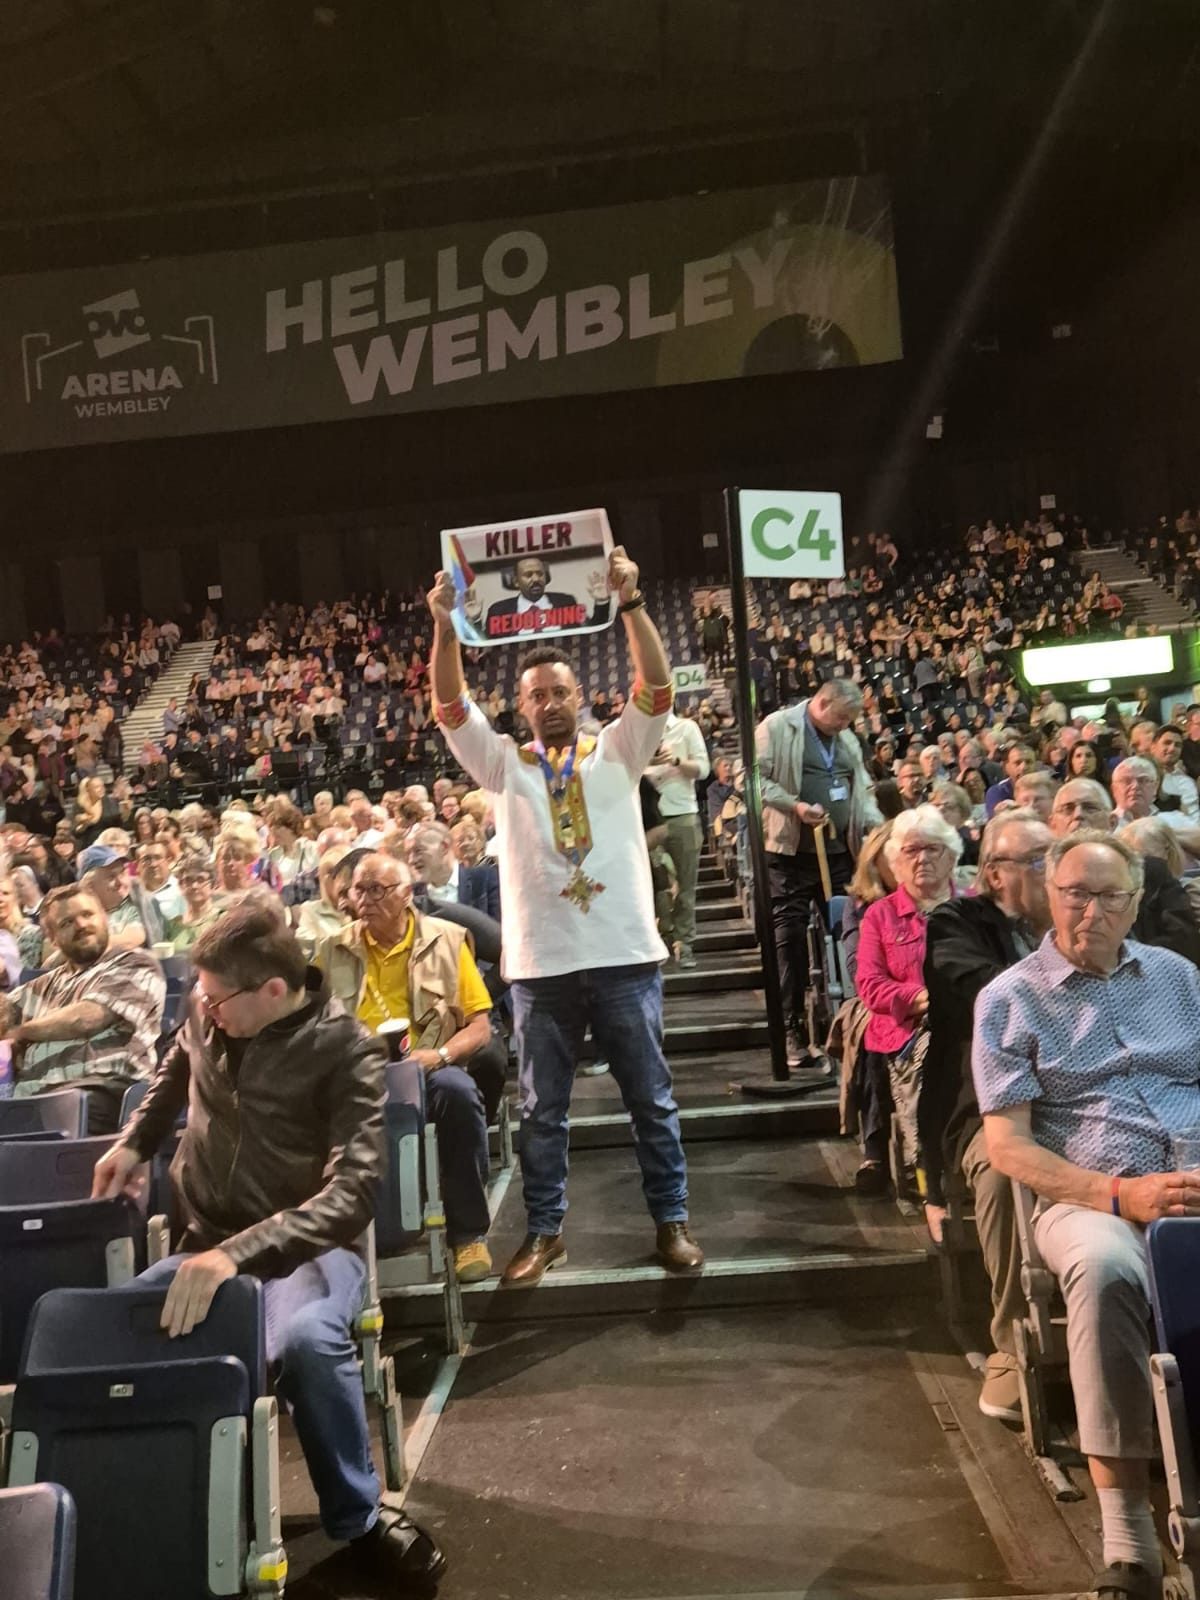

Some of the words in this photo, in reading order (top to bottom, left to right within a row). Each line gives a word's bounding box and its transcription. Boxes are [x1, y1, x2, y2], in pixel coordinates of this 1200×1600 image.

[266, 230, 548, 353] HELLO
[333, 238, 794, 404] WEMBLEY
[60, 365, 183, 400] ARENA
[74, 396, 172, 418] WEMBLEY
[485, 521, 572, 557] KILLER
[751, 507, 837, 561] C4
[676, 669, 703, 687] D4
